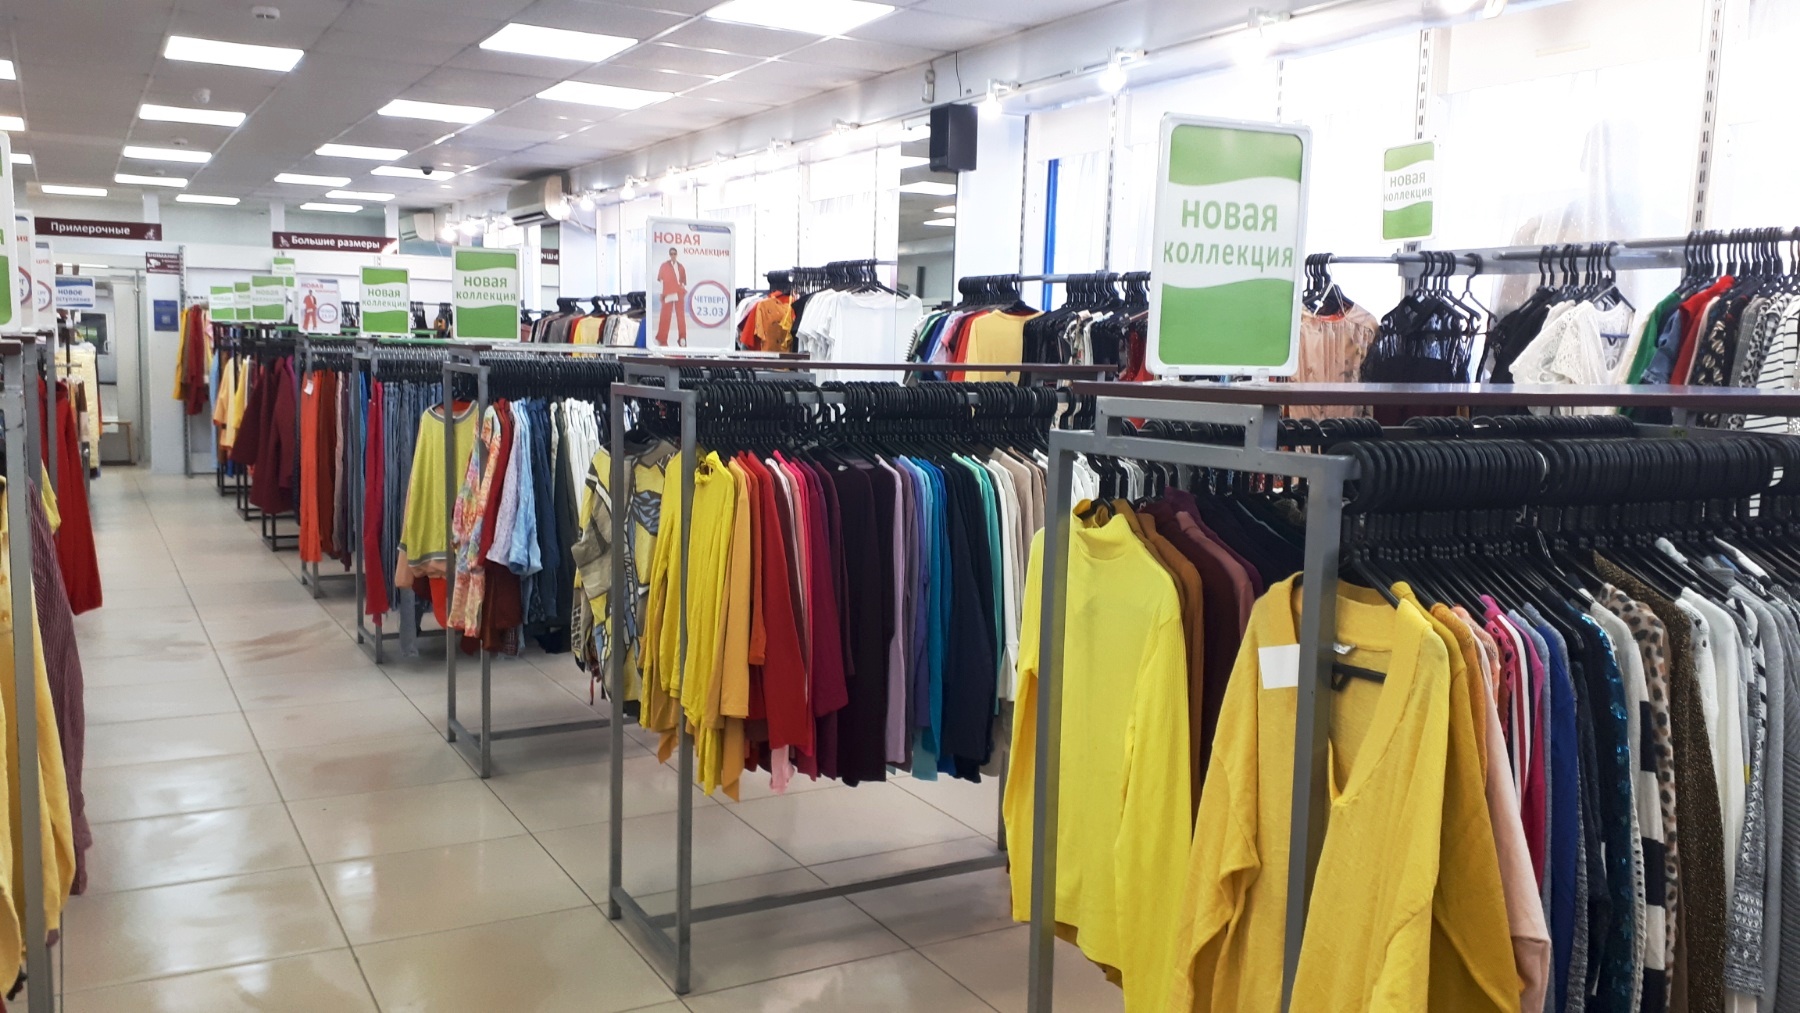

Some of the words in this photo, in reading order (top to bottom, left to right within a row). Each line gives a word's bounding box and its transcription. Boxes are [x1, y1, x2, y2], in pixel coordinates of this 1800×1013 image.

[1390, 172, 1426, 188] новая
[1383, 187, 1432, 202] коллекция
[1181, 199, 1278, 232] новая
[51, 222, 130, 235] Примерочные
[291, 235, 335, 246] Большие
[337, 238, 380, 250] размеры
[654, 231, 701, 246] НОВАЯ
[684, 247, 729, 257] КОЛЛЕКЦИЯ
[1164, 241, 1293, 273] коллекция
[463, 276, 507, 288] новая
[58, 288, 83, 296] новое
[367, 287, 401, 298] новая
[456, 290, 516, 302] коллекция
[362, 300, 407, 309] коллекция
[694, 295, 725, 304] ЧЕТВЕРГ
[697, 307, 724, 317] 23.03
